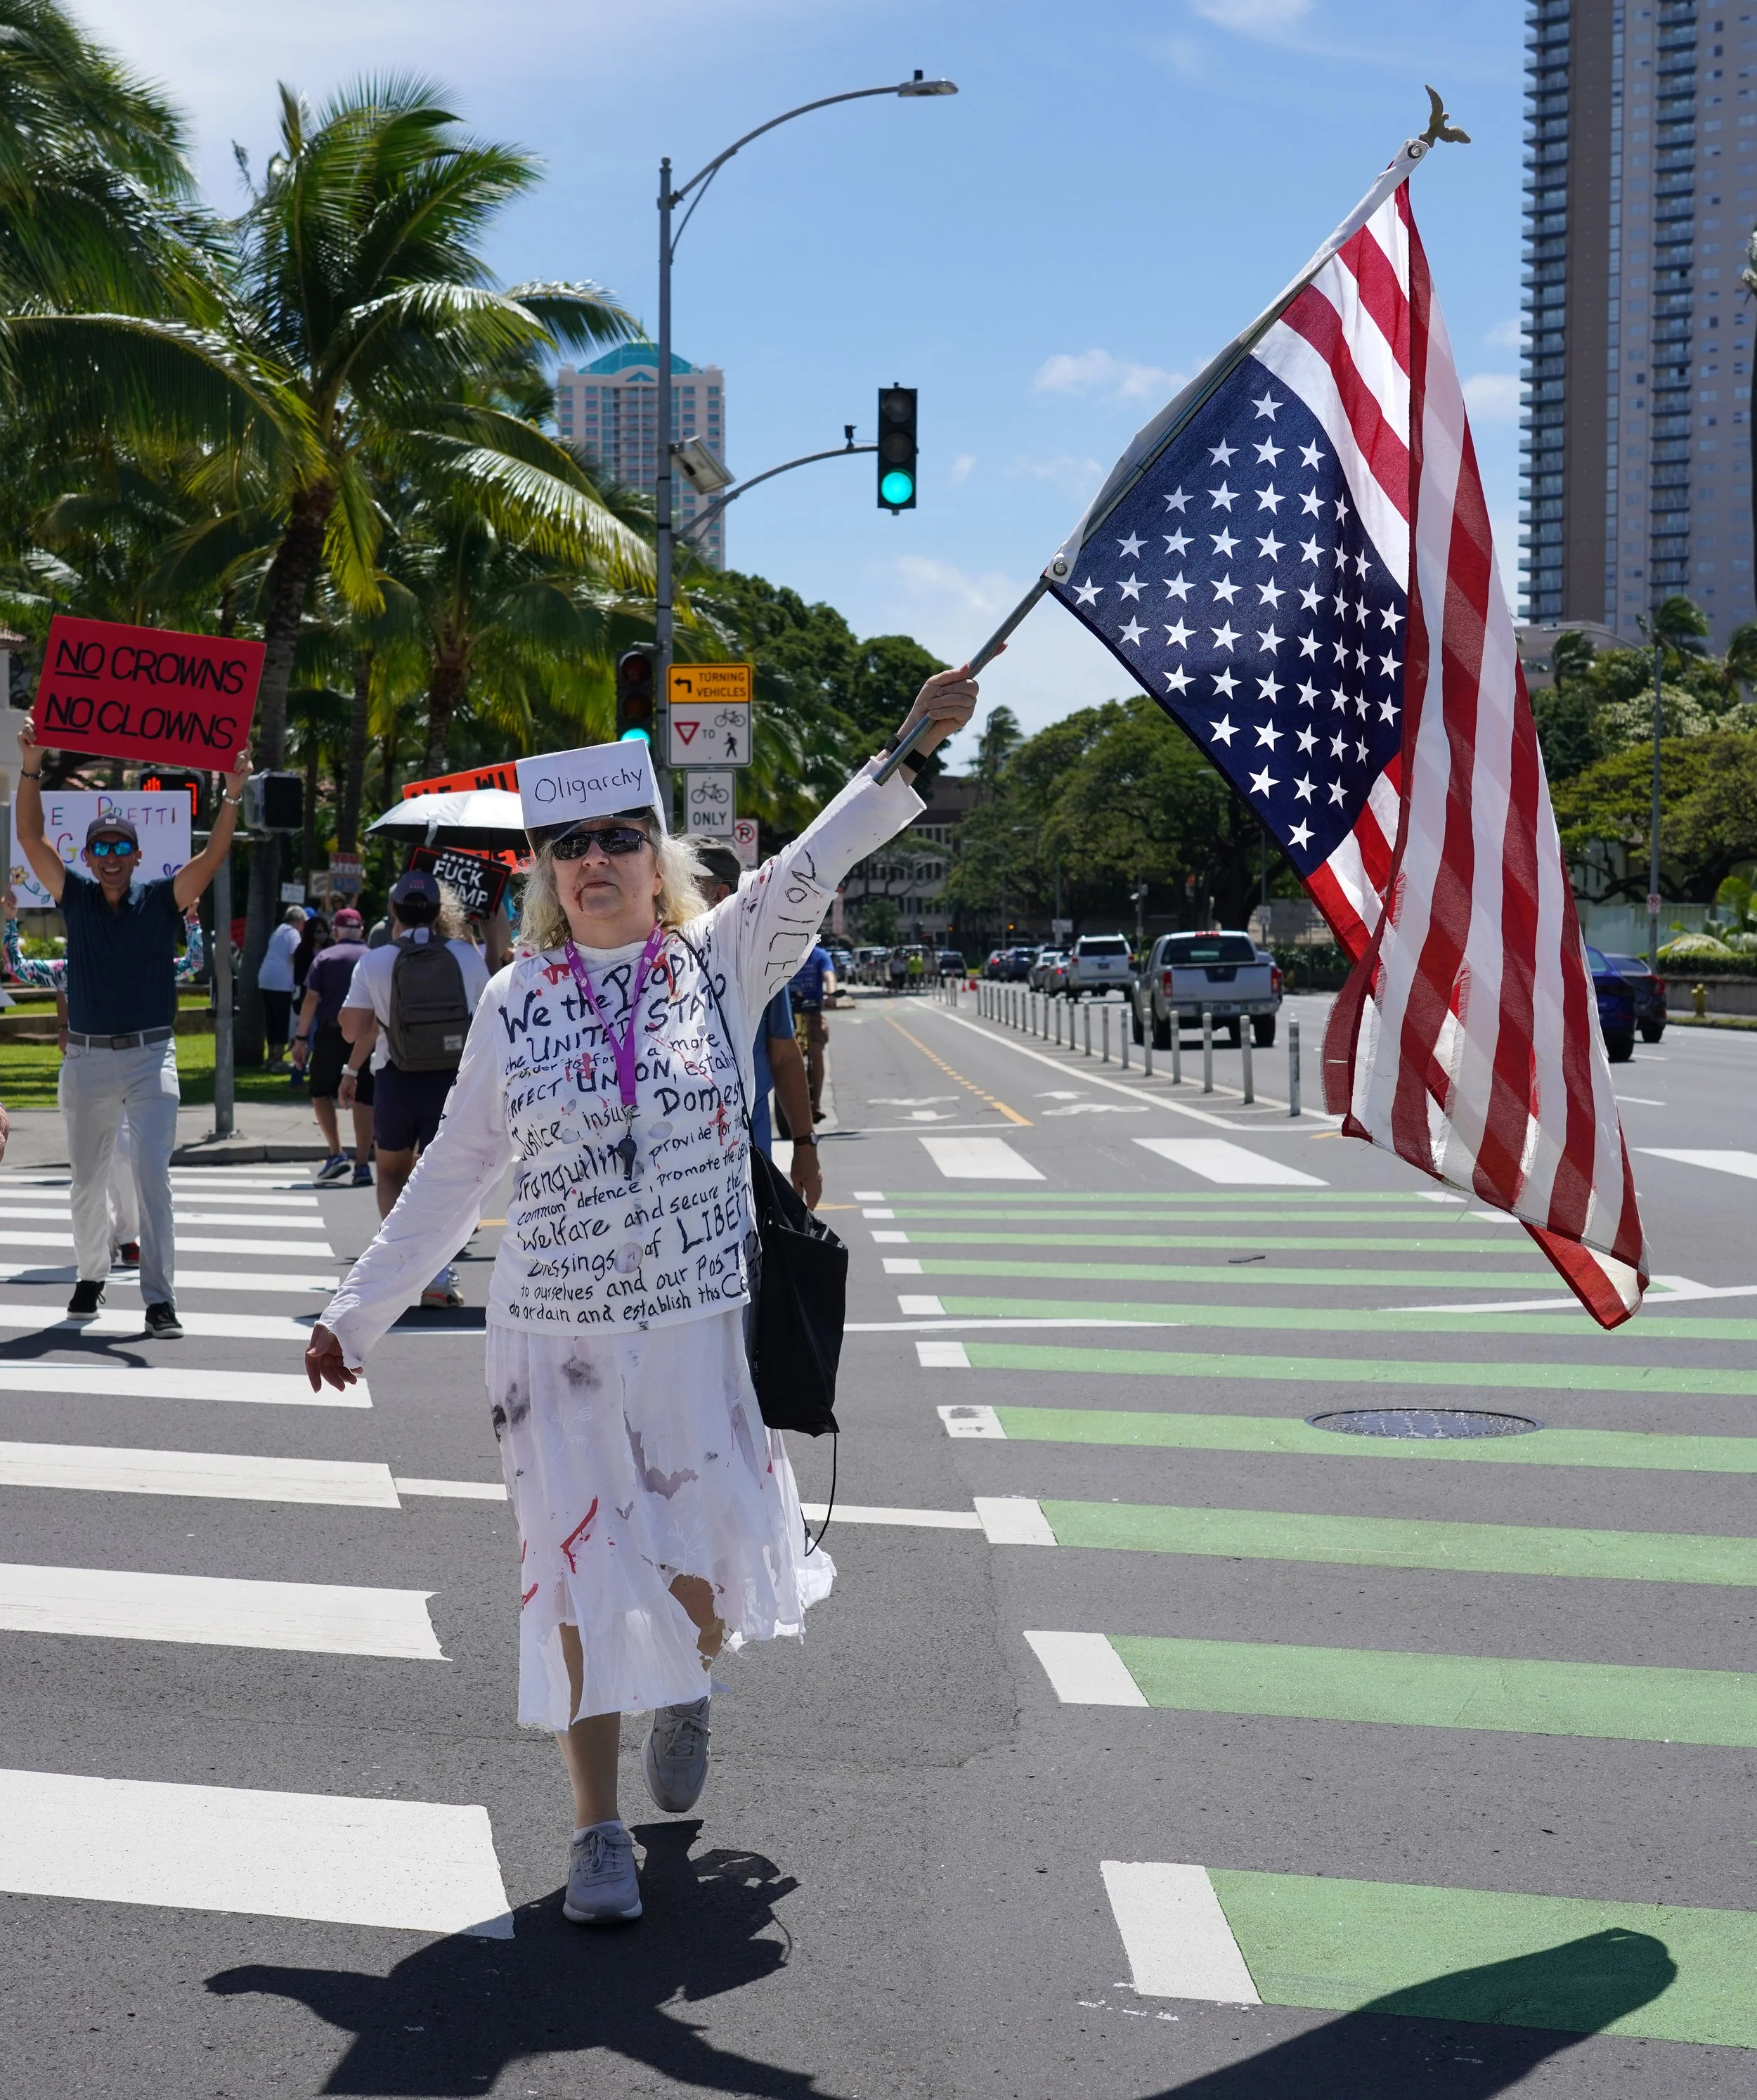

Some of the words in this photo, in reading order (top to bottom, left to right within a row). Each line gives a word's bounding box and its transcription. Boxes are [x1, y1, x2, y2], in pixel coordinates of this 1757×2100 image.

[56, 640, 105, 675] NO
[111, 646, 247, 694] CROWNS
[699, 672, 745, 682] TURNING
[696, 687, 746, 697] VEHICLES
[44, 694, 94, 728] NO
[97, 701, 237, 749] CLOWNS
[702, 730, 715, 739] TO
[536, 768, 642, 803] Oligarchy
[693, 812, 727, 825] ONLY
[433, 860, 484, 888] FUCK
[498, 990, 552, 1044] We
[561, 982, 614, 1021] the
[602, 945, 708, 1019] Pople
[566, 1058, 581, 1069] to
[591, 1053, 615, 1067] for
[647, 1047, 661, 1056] a
[669, 1033, 720, 1052] more
[507, 1077, 563, 1124] ERFECT
[649, 1127, 712, 1167] provide
[517, 1203, 566, 1226] common
[657, 1158, 720, 1186] promote
[517, 1215, 611, 1251] Welfare
[624, 1195, 665, 1228] and
[669, 1185, 719, 1213] secure
[727, 1169, 741, 1193] the
[644, 1227, 662, 1258] of
[521, 1283, 529, 1297] to
[534, 1282, 593, 1301] ourselves
[607, 1267, 647, 1297] and
[656, 1267, 688, 1290] our
[510, 1299, 520, 1318] do
[523, 1303, 571, 1323] ordain
[577, 1304, 616, 1323] and
[623, 1289, 692, 1321] establish
[698, 1283, 720, 1304] this
